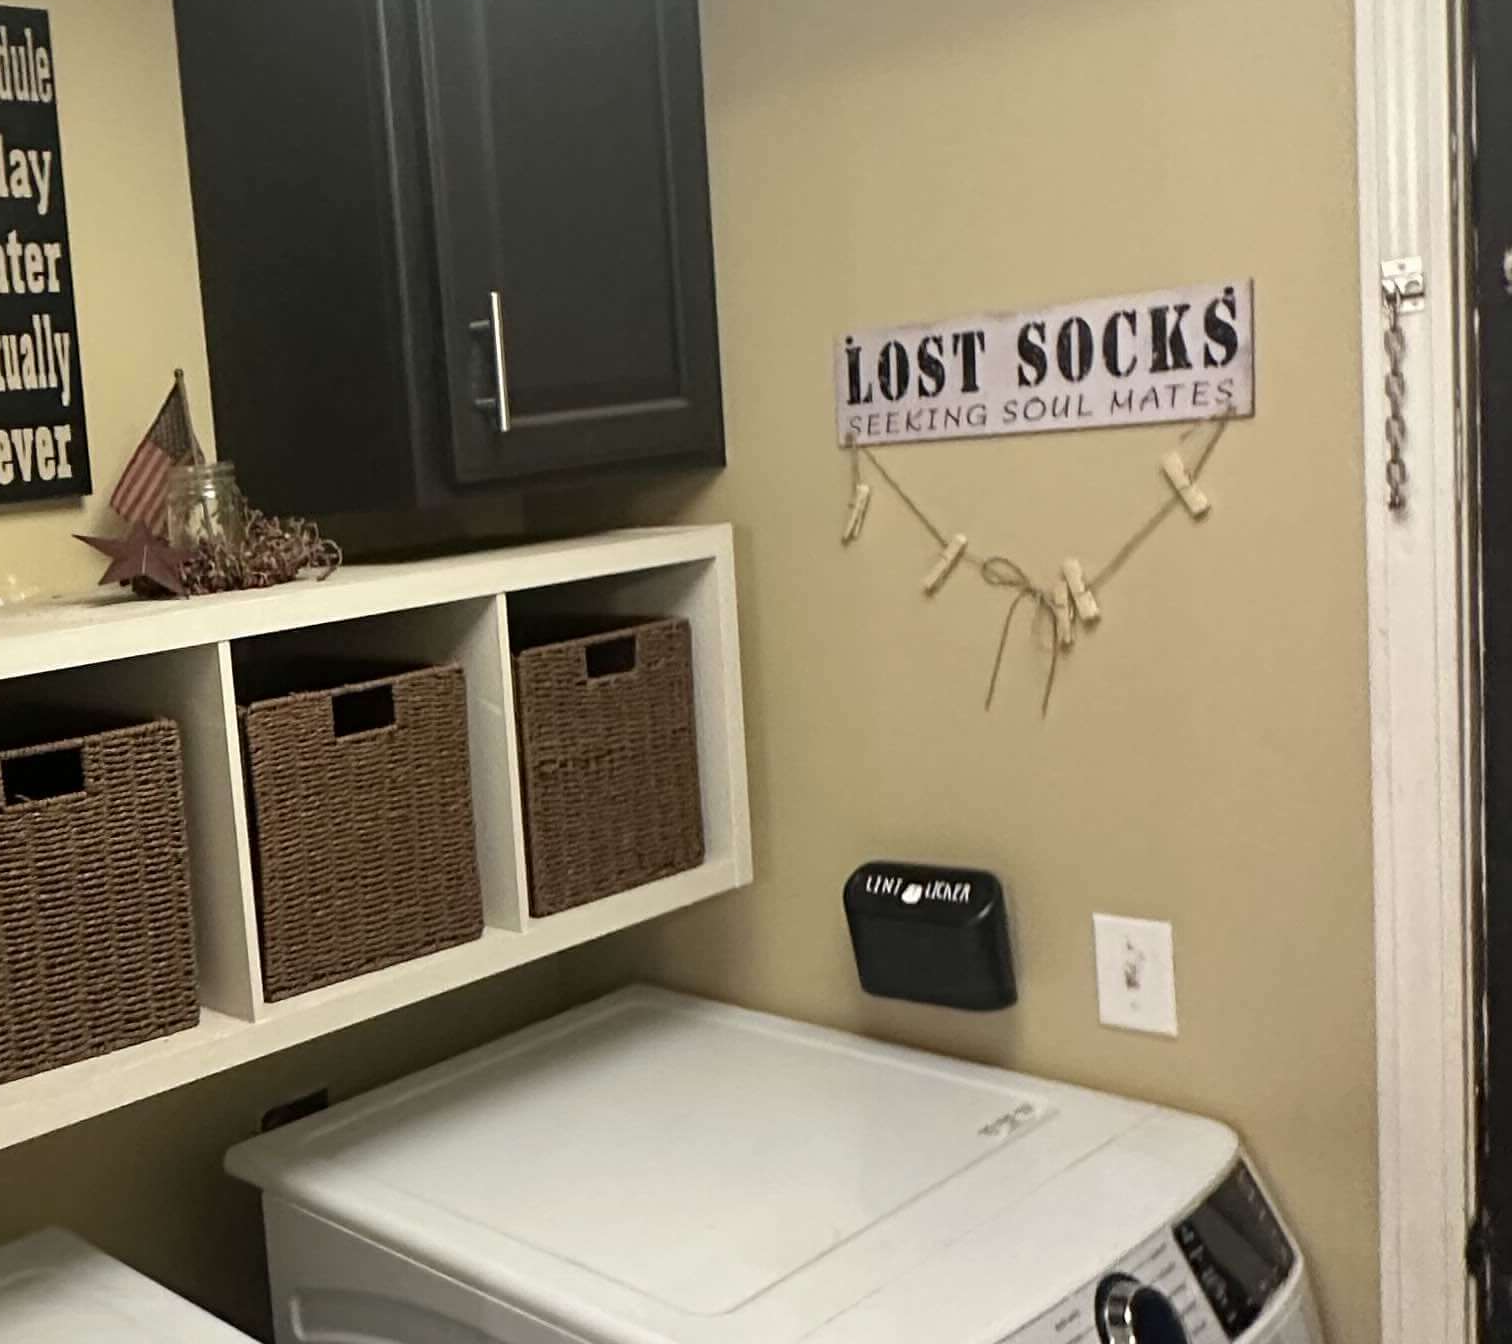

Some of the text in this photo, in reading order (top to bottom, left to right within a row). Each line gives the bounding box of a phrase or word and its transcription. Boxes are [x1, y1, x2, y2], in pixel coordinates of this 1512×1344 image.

[845, 295, 1239, 406] LOST SOCKS
[847, 378, 1236, 440] SEEKING SOUL MATES
